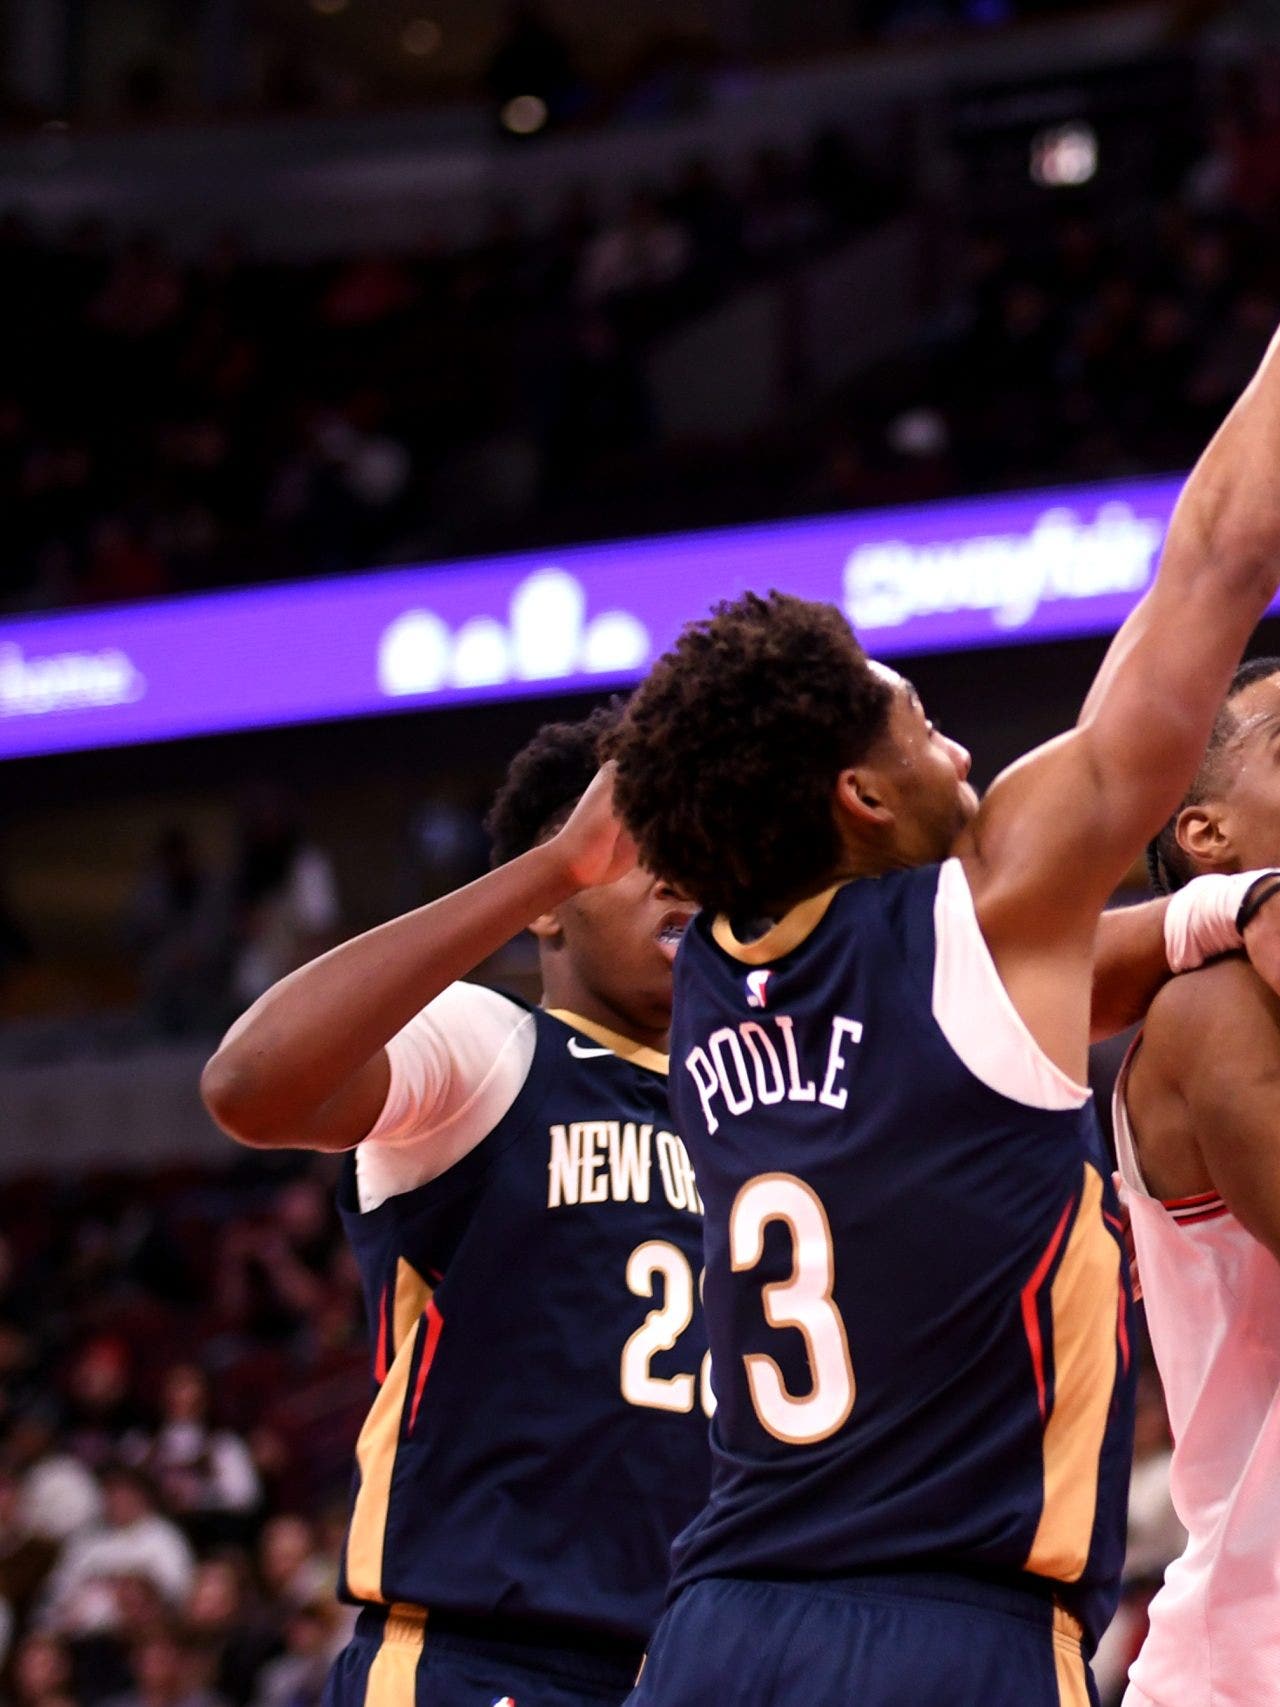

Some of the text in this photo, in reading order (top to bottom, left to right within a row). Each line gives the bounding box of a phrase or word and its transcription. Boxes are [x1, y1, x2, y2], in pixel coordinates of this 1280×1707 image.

[686, 1015, 863, 1135] POOLE
[547, 1121, 653, 1208] NEW
[620, 1240, 717, 1419] 2
[730, 1172, 856, 1445] 3
